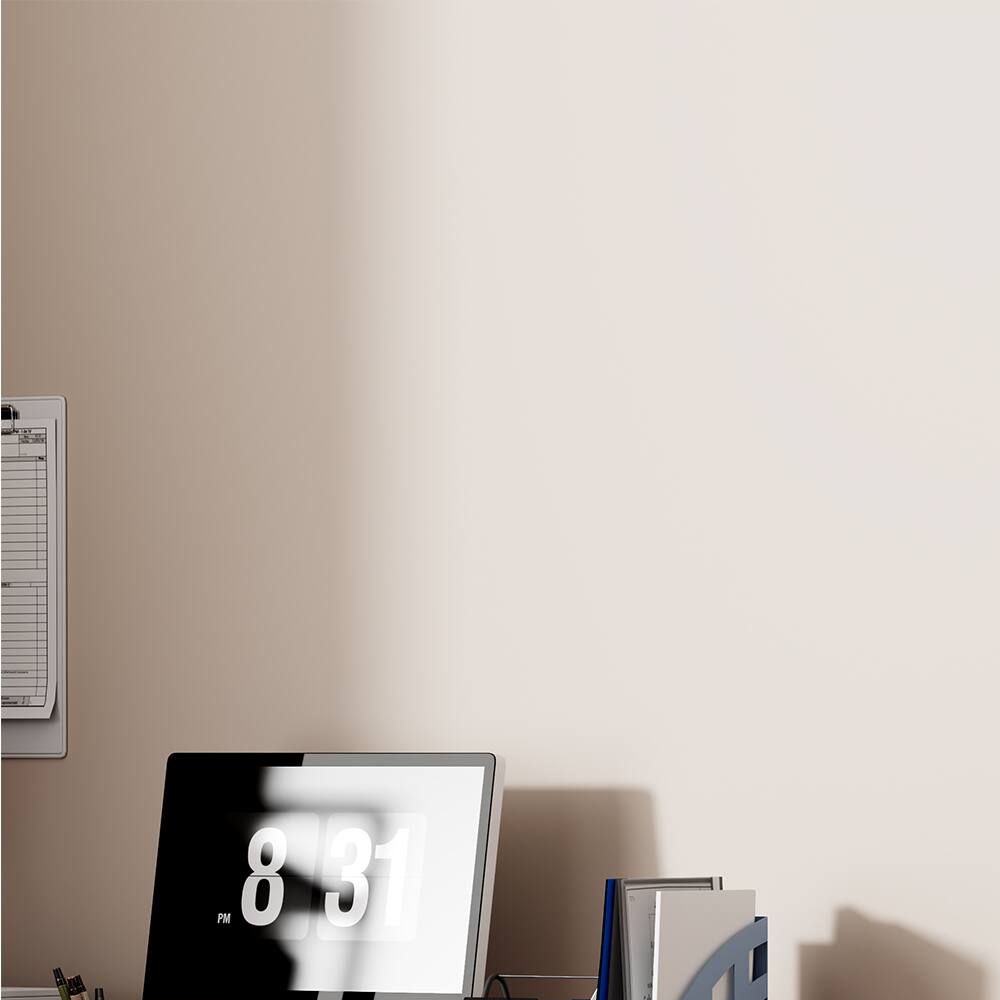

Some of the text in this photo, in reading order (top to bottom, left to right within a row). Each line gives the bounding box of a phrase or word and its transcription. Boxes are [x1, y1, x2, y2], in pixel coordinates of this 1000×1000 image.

[241, 827, 410, 928] 8 31
[217, 913, 231, 924] PM
